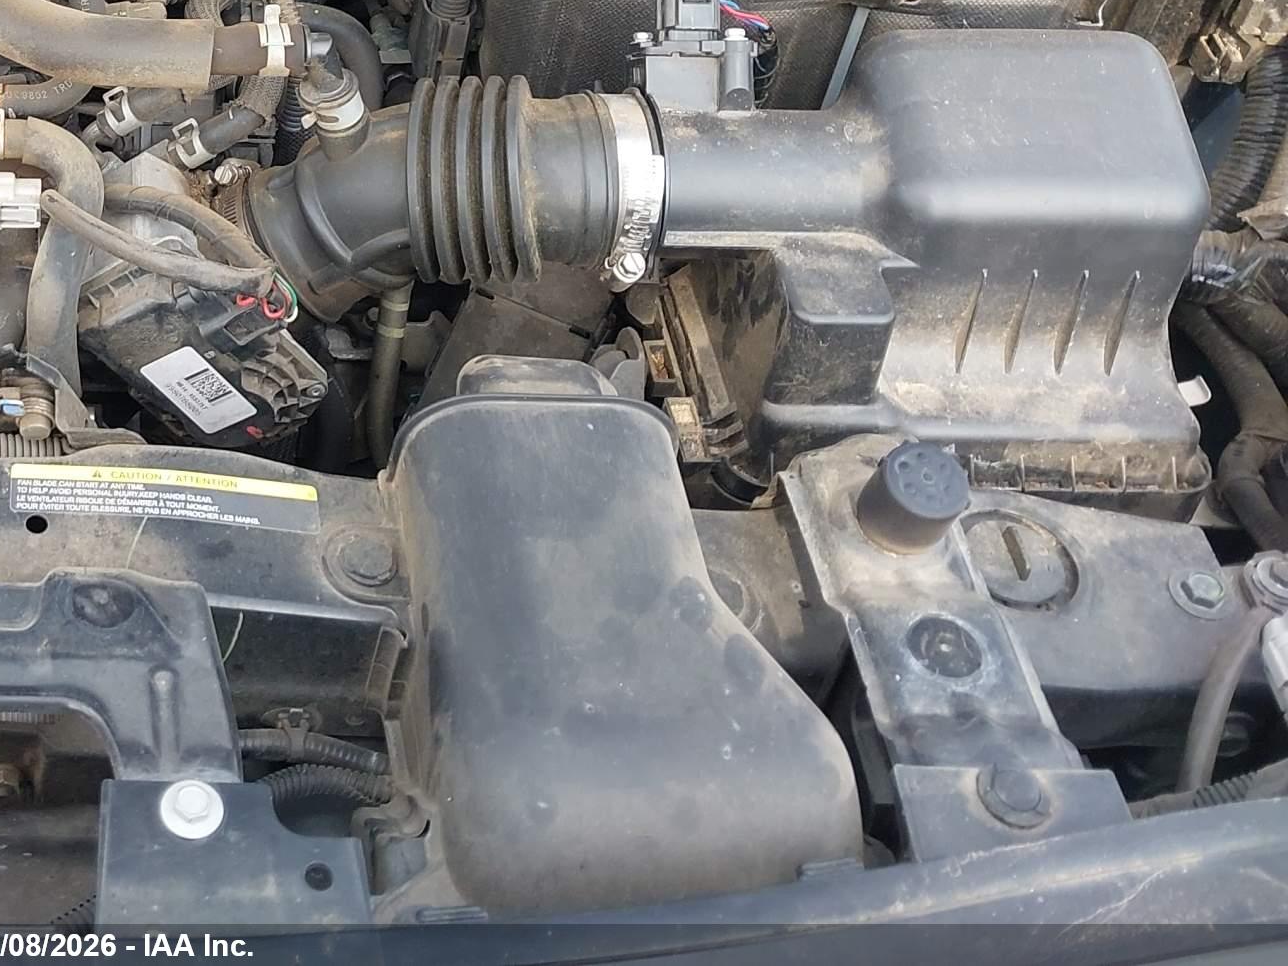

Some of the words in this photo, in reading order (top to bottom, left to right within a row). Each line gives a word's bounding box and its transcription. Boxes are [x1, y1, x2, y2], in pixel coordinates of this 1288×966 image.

[110, 470, 162, 481] CAUTION
[175, 475, 238, 488] ATTENTION
[17, 486, 27, 494] TO
[73, 489, 112, 497] PERSONAL
[159, 492, 186, 501] HANDS
[16, 502, 38, 510] POUR
[39, 502, 64, 511] ÉVITER
[65, 504, 89, 512] TOUTE
[144, 507, 160, 515] PAS
[172, 509, 219, 520] APPROCHER
[220, 514, 234, 522] LES
[27, 495, 74, 504] VENTILATEUR
[165, 501, 186, 509] TOUT
[186, 503, 220, 513] MOMENT.
